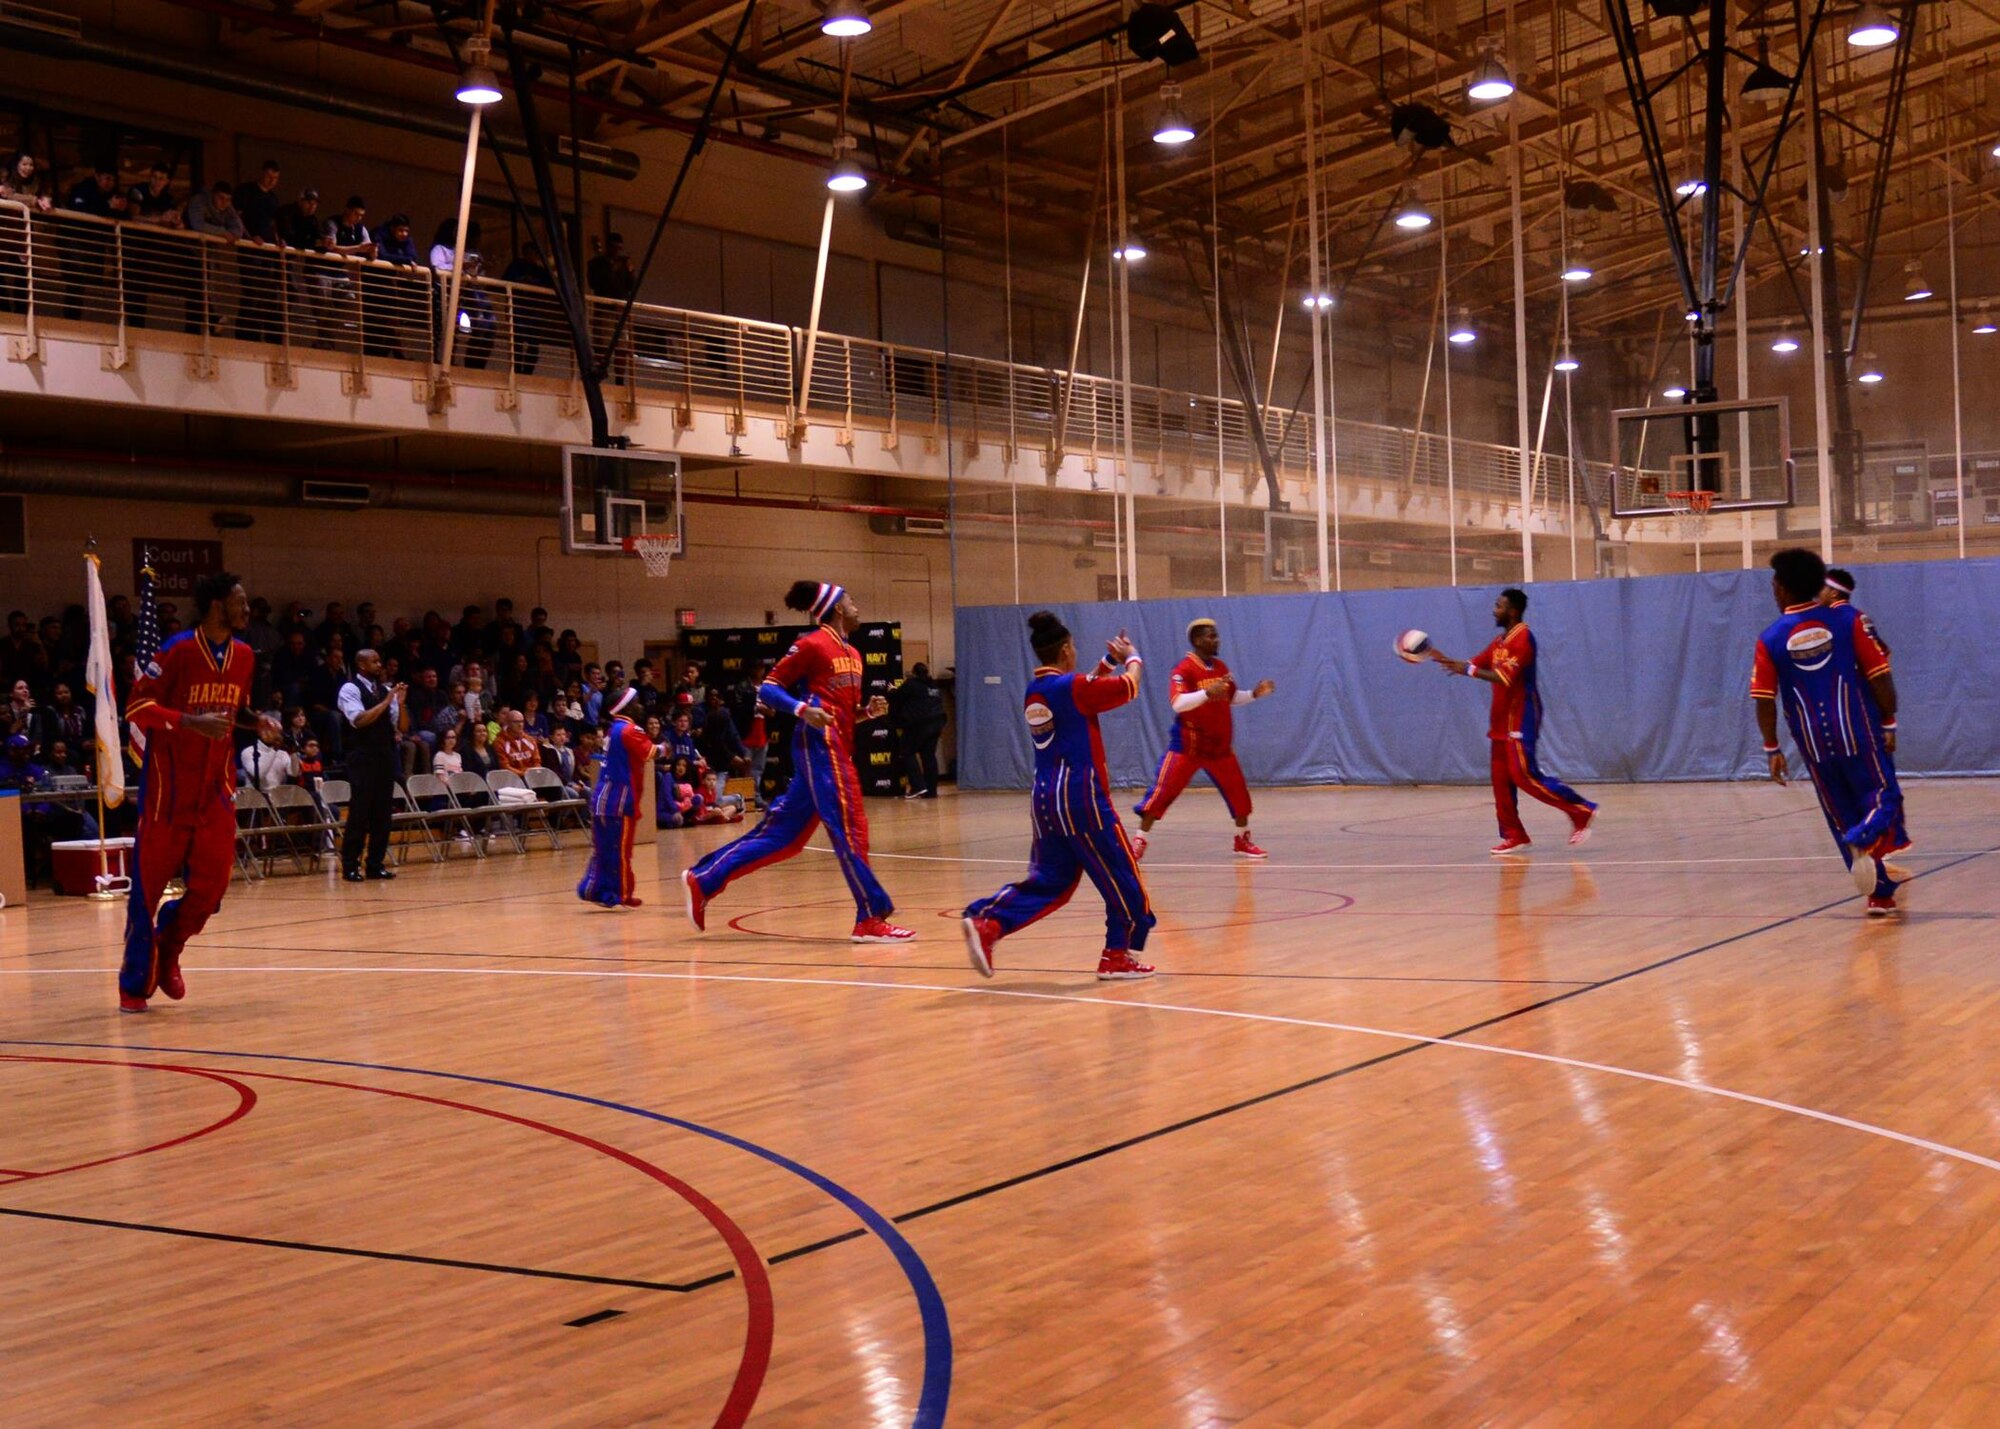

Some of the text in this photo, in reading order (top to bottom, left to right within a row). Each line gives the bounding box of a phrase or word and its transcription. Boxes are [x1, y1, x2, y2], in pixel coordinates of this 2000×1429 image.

[148, 545, 209, 564] Court 1
[152, 573, 188, 590] Side
[866, 653, 887, 665] NAVY
[870, 752, 892, 765] NAVY
